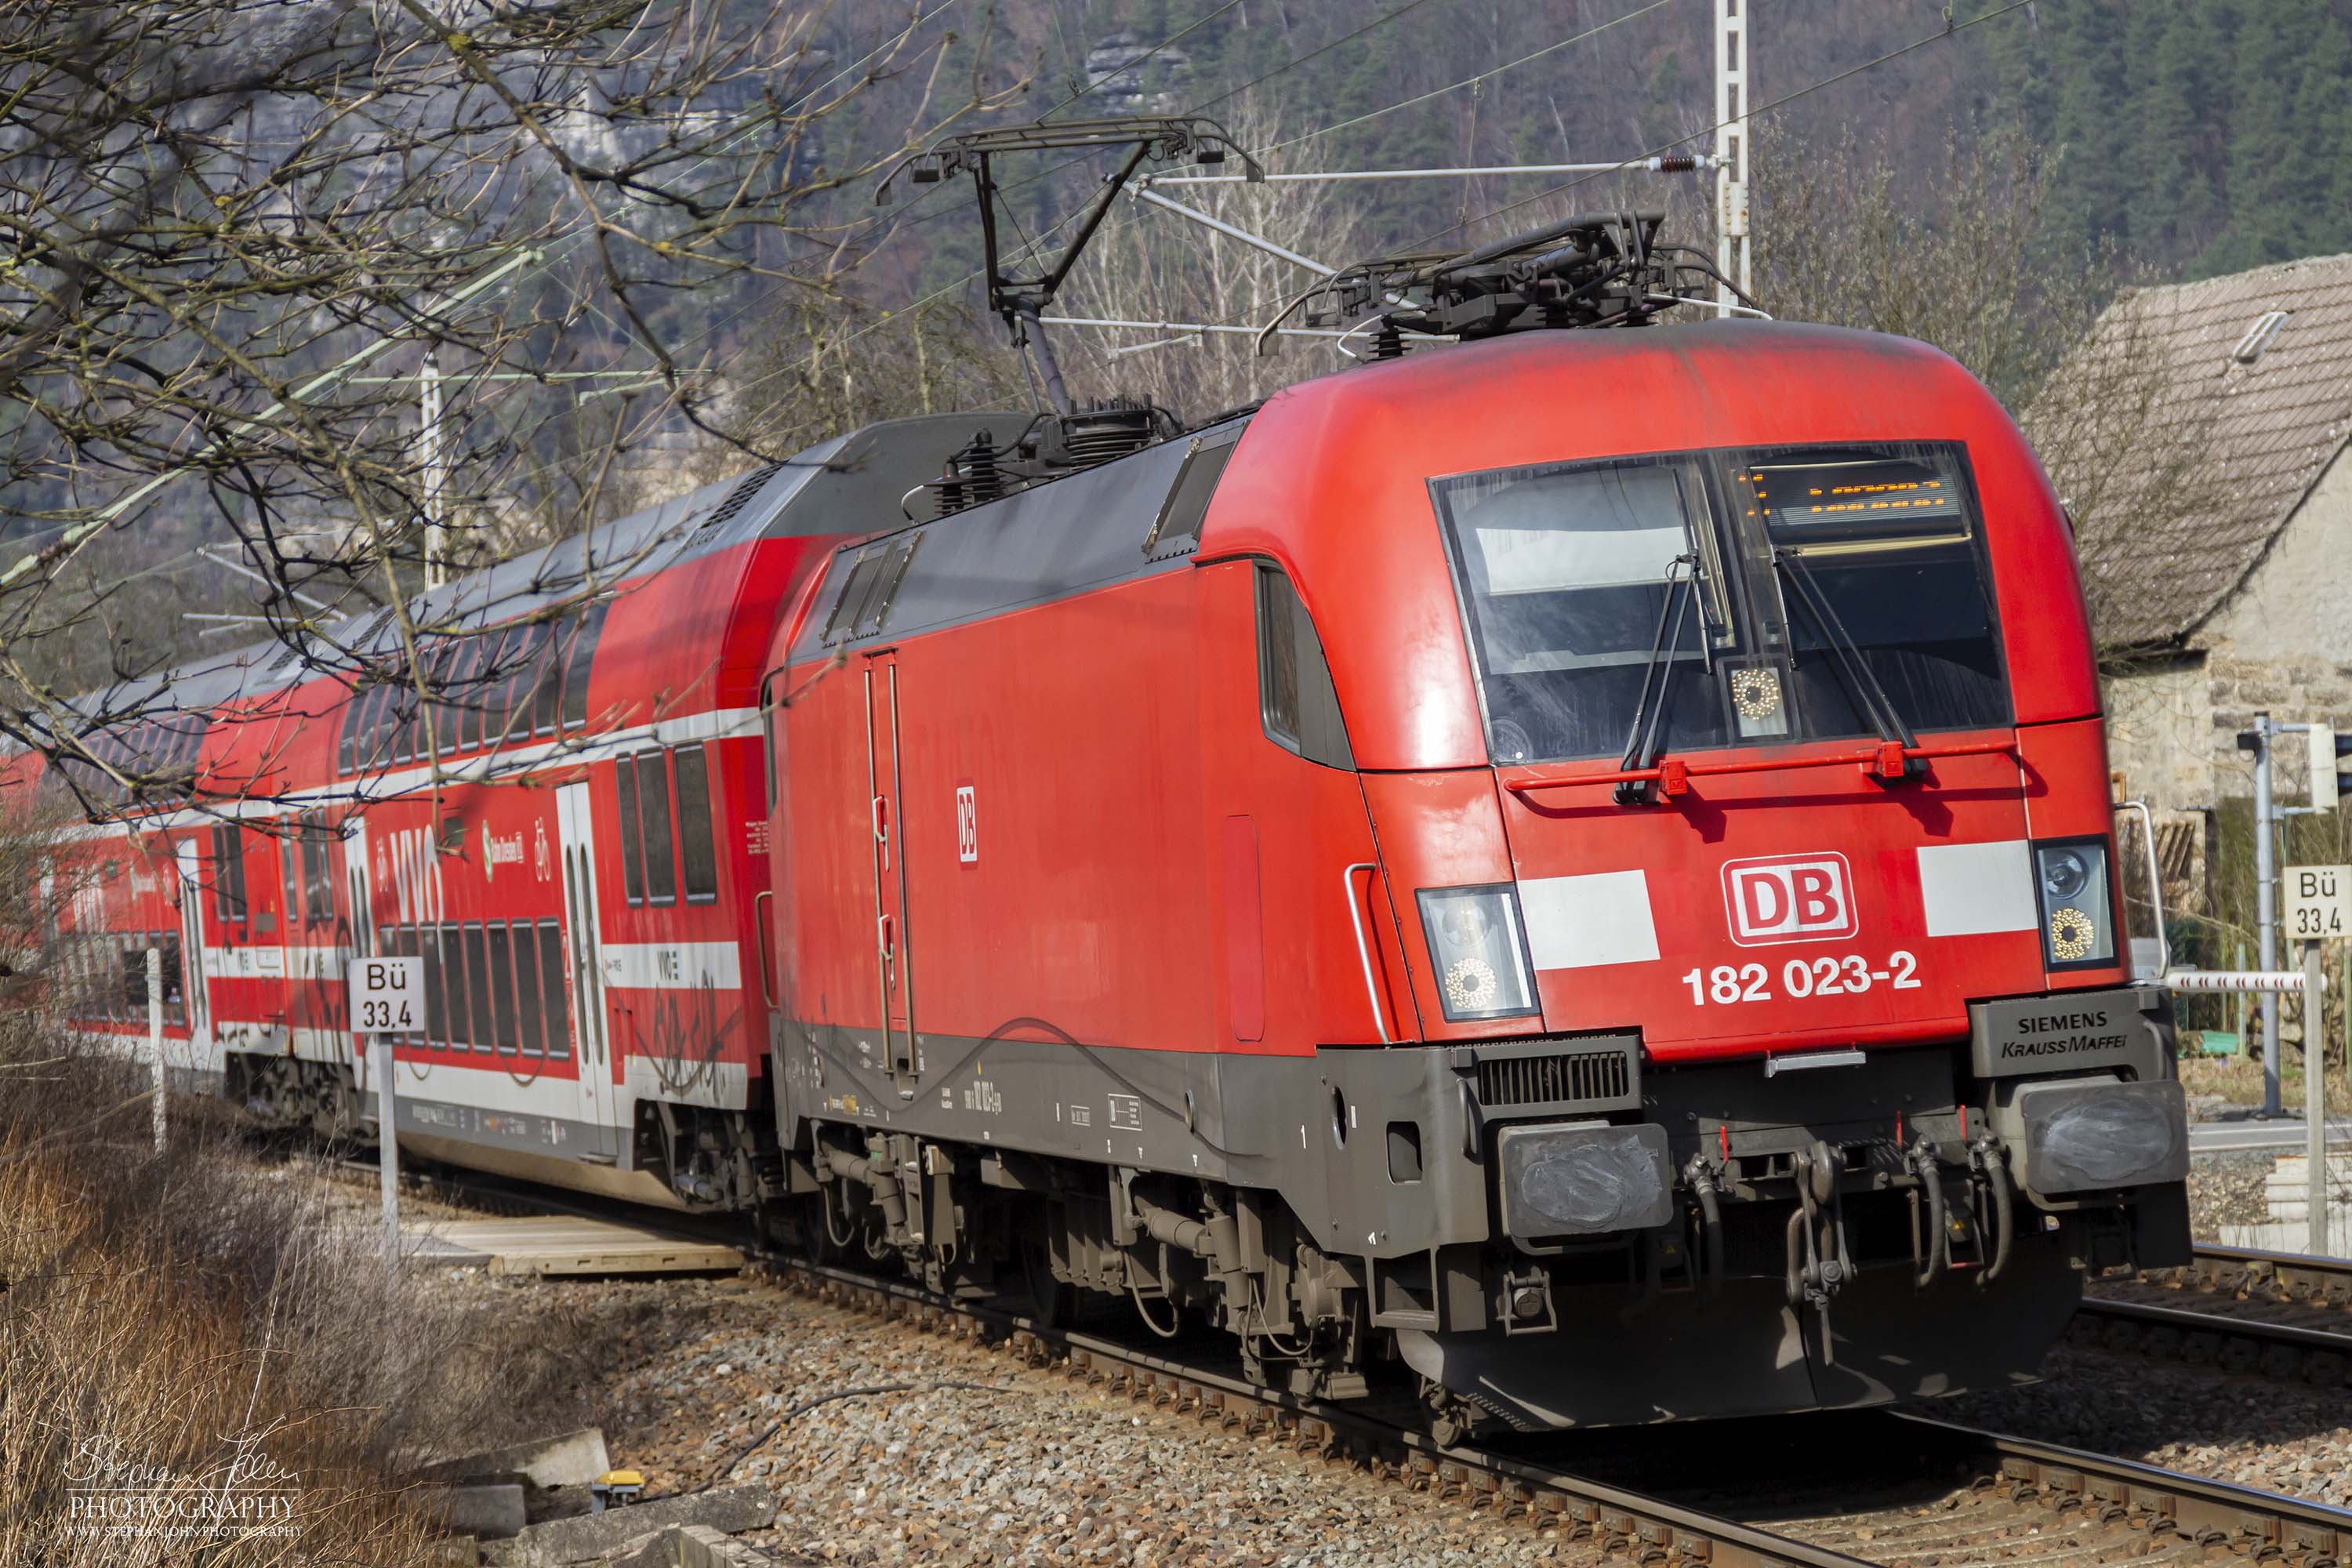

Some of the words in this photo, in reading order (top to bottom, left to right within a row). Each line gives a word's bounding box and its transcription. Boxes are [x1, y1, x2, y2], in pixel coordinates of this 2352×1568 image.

[959, 793, 975, 854] DB
[2300, 871, 2336, 898] Bü
[1740, 869, 1838, 929] DB
[2297, 907, 2342, 935] 33,4
[367, 963, 406, 991] Bü
[1682, 963, 1772, 1006] 182
[1783, 950, 1922, 998] 023-2
[363, 1000, 412, 1029] 33,4
[2018, 1011, 2107, 1034] SIEMENS
